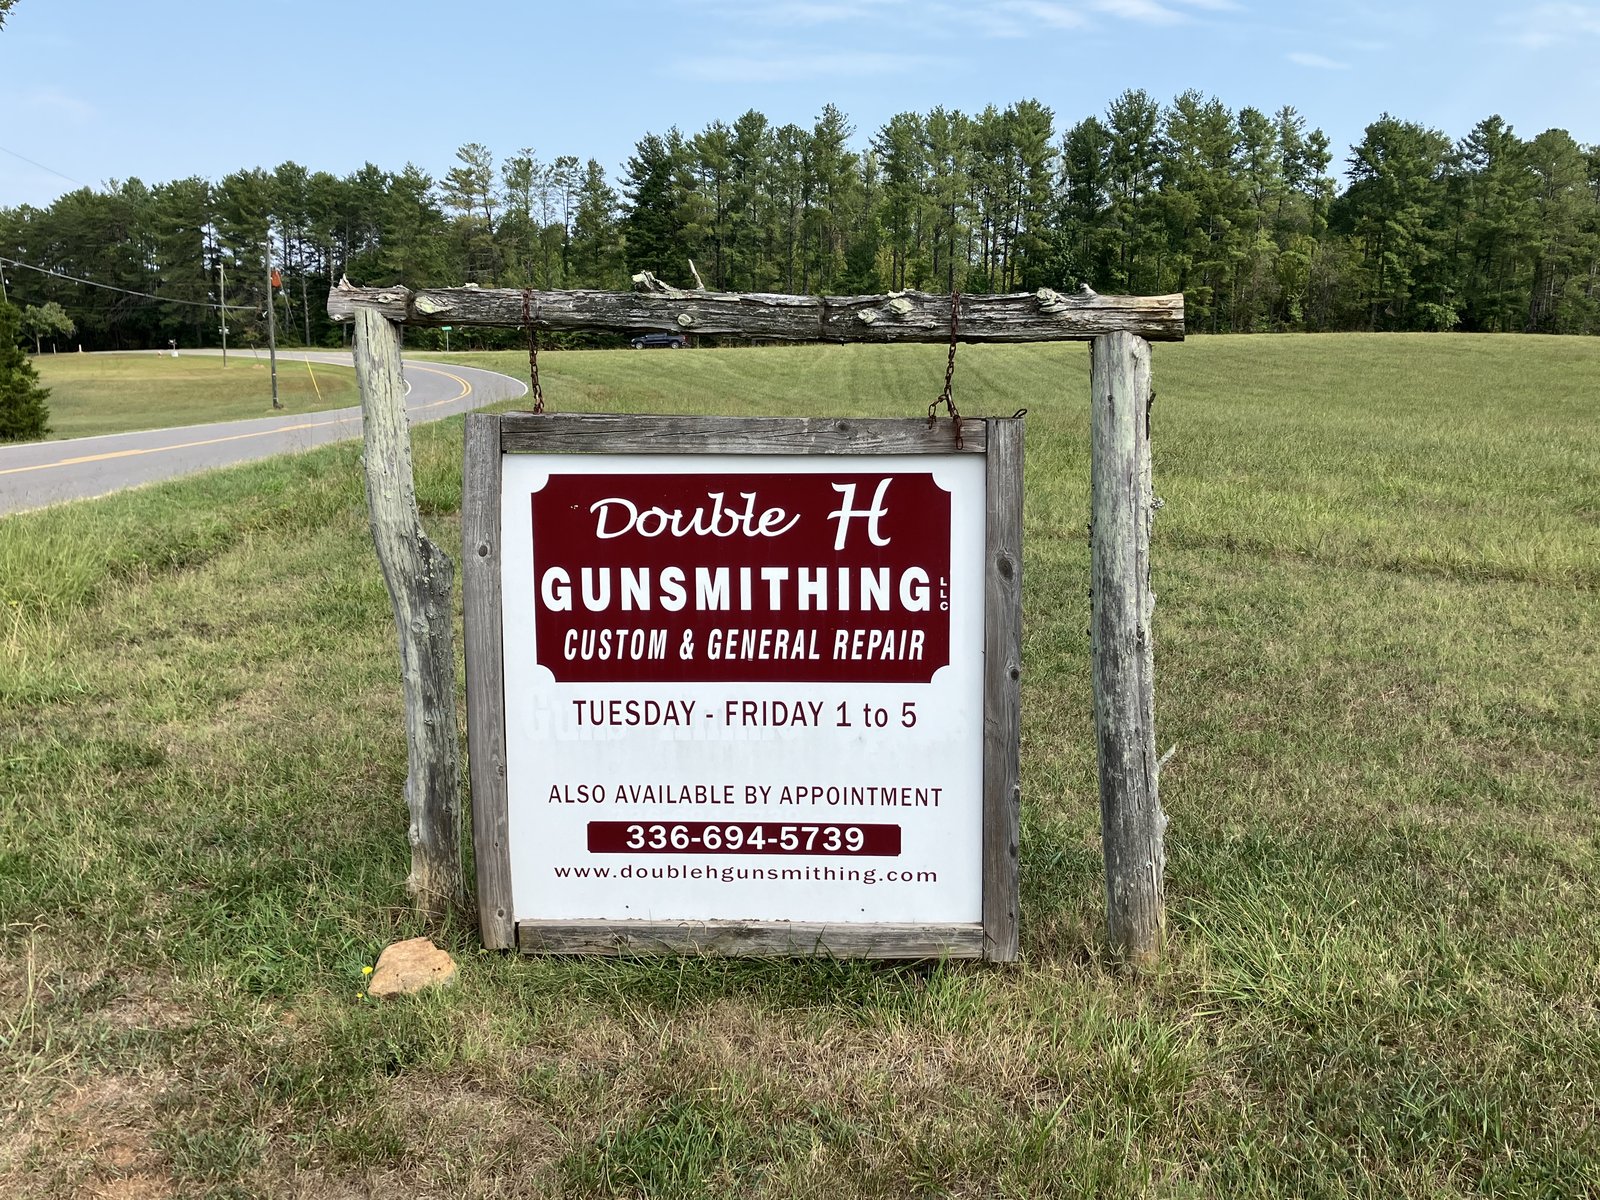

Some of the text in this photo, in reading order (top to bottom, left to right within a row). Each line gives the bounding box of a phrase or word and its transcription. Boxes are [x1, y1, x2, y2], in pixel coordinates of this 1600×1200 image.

[590, 478, 892, 551] Double H
[541, 566, 931, 612] GUNSMITHING
[940, 576, 949, 611] LLC
[564, 629, 925, 660] CUSTOM & GENERAL REPAIR
[573, 700, 695, 726] TUESDAY
[726, 701, 823, 727] FRIDAY
[836, 701, 852, 727] 1
[863, 703, 889, 728] to
[901, 702, 917, 728] 5
[549, 785, 943, 807] ALSO AVAILABLE BY APPOINTMENT
[626, 825, 864, 851] 336-694-5739
[554, 865, 937, 884] www.doublehgunsmithing.com
